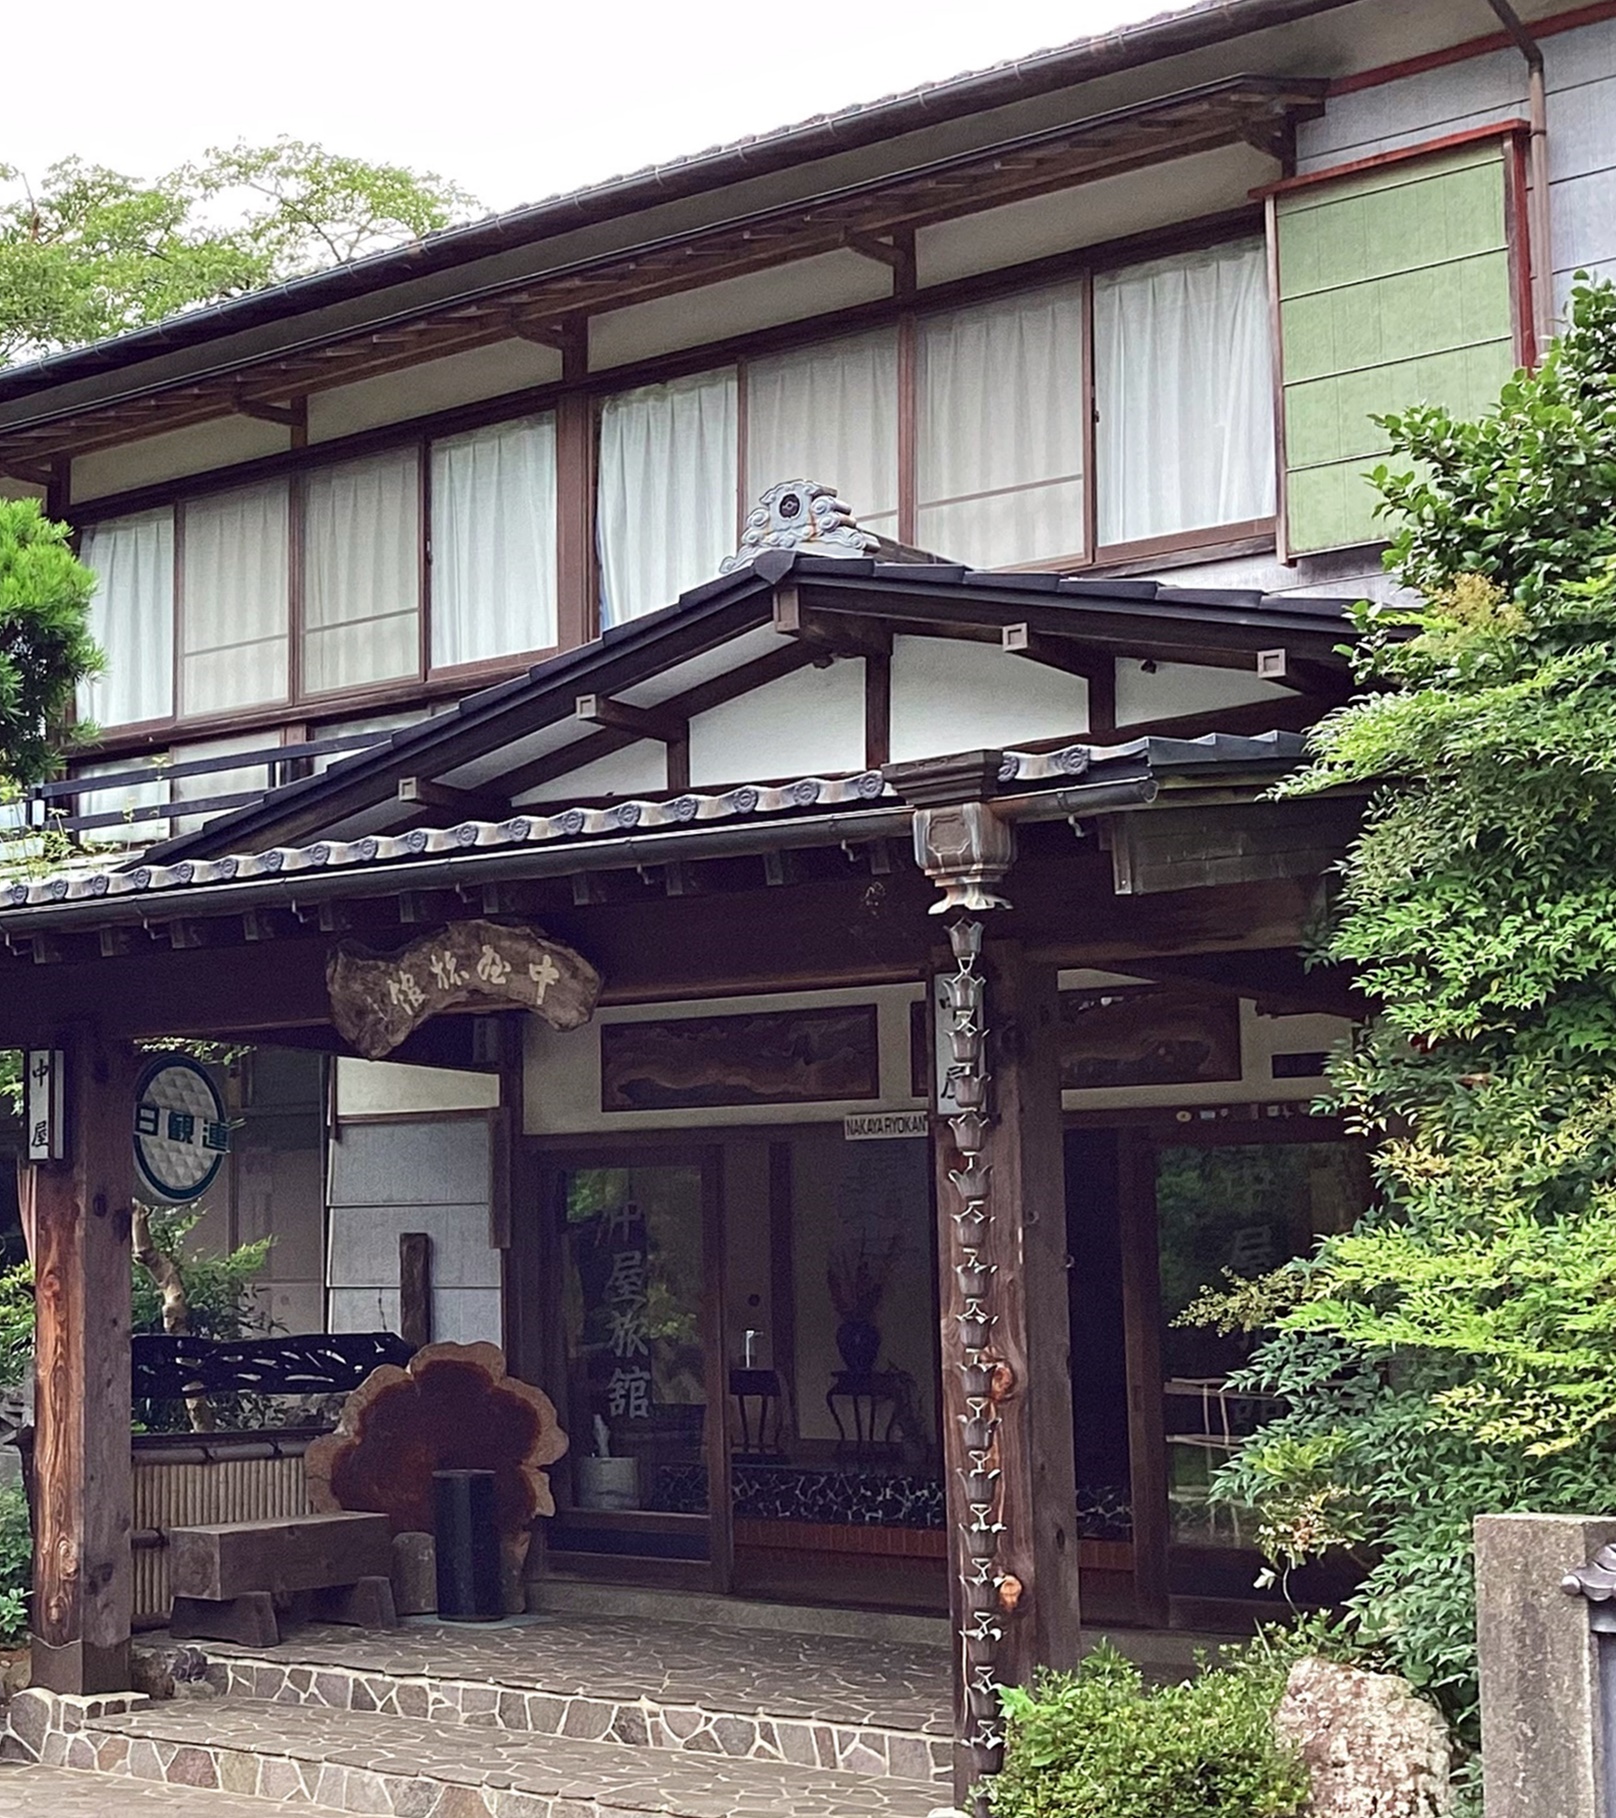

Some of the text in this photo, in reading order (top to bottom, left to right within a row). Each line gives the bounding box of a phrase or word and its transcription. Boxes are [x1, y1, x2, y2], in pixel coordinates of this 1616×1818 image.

[31, 1058, 49, 1148] 中屋
[135, 1102, 230, 1152] 日観連
